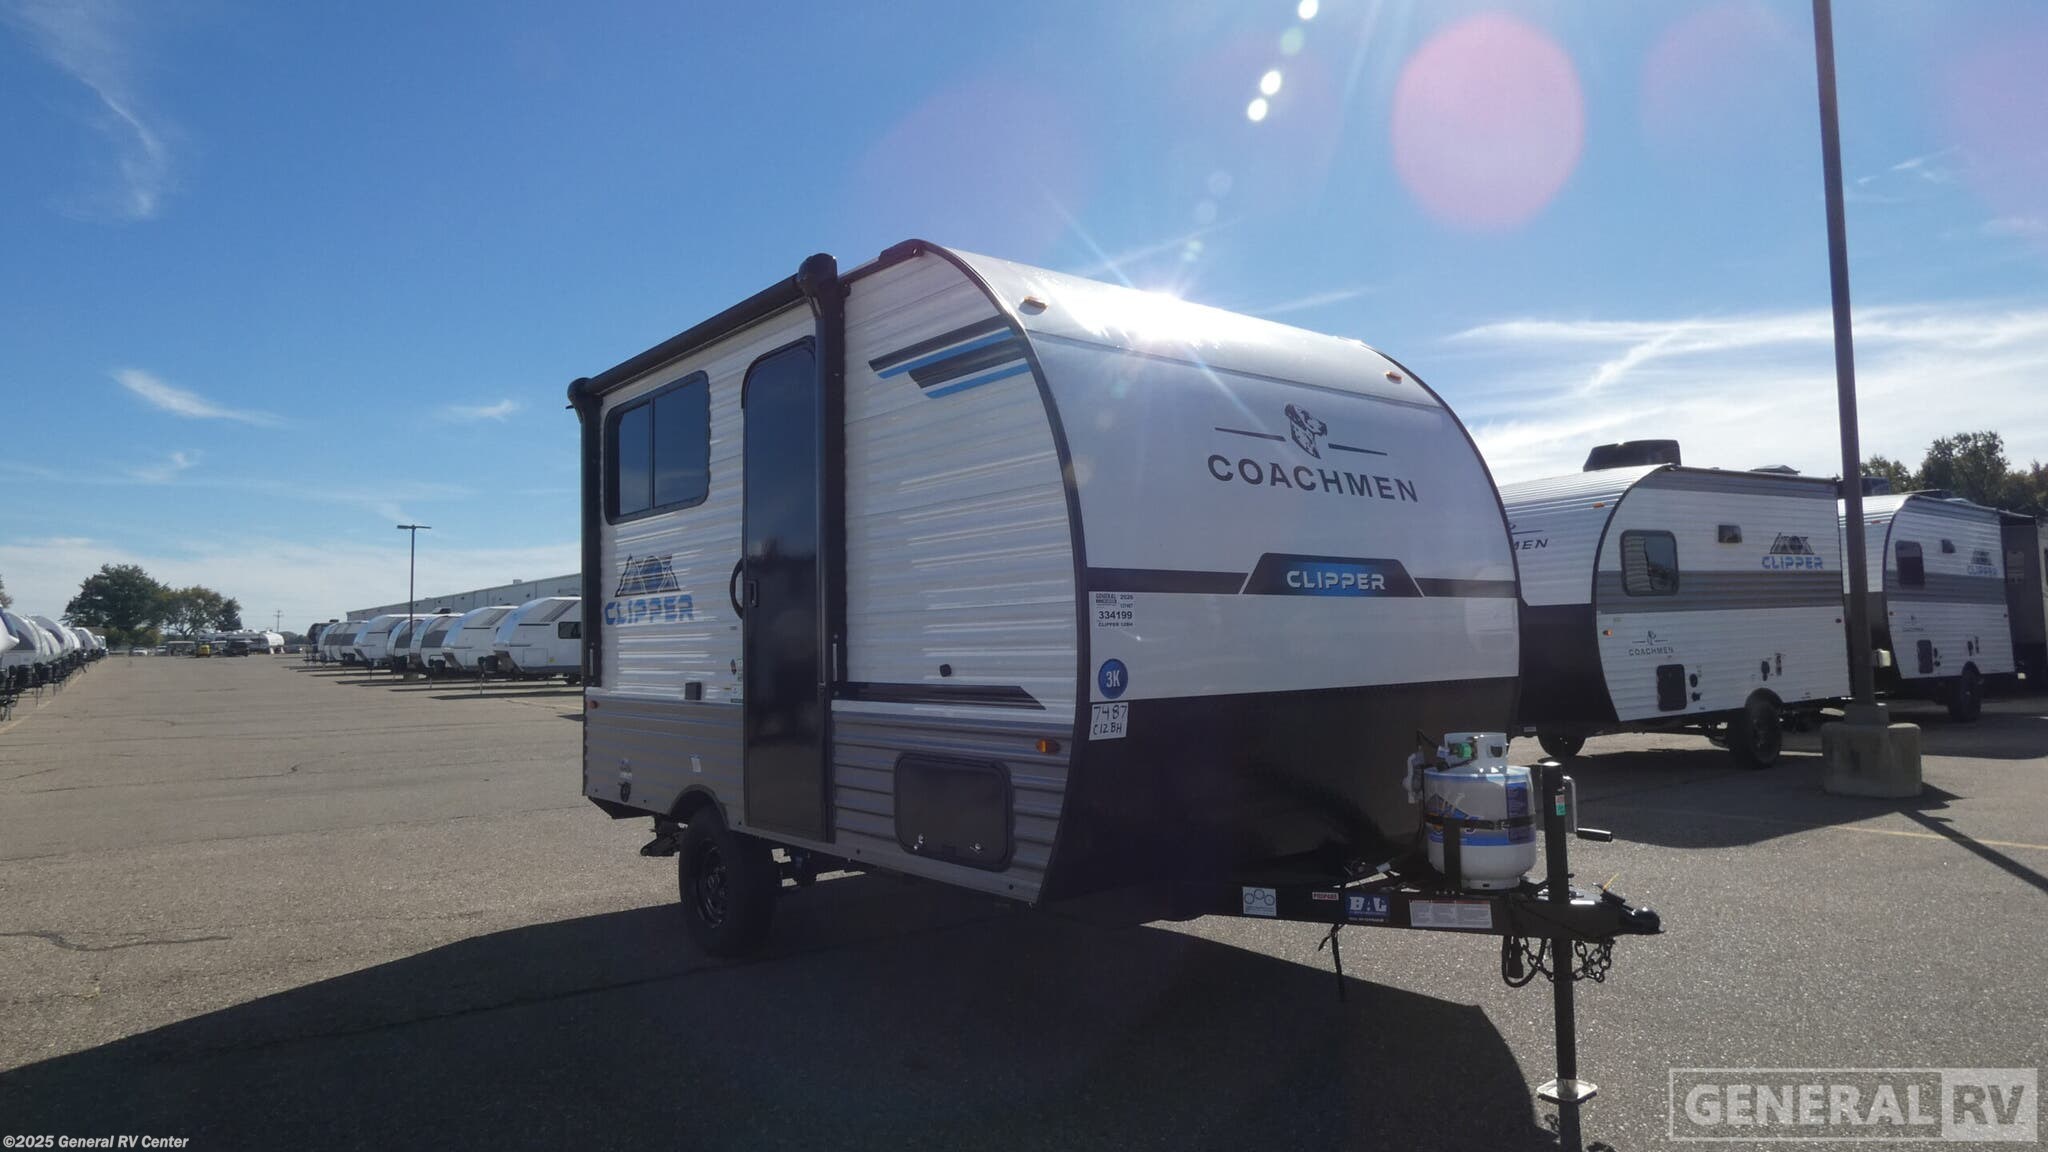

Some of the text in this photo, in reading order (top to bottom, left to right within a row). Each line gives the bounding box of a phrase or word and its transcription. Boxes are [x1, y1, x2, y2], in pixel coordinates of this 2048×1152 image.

[1207, 454, 1418, 503] COACHMEN
[1761, 555, 1824, 569] CLIPPER
[1286, 570, 1386, 590] CLIPPER
[604, 594, 695, 625] CLIPPER
[1098, 611, 1132, 620] 334199
[1628, 646, 1674, 657] COACHMEN
[1105, 669, 1121, 688] 3K
[1093, 704, 1128, 721] 7487
